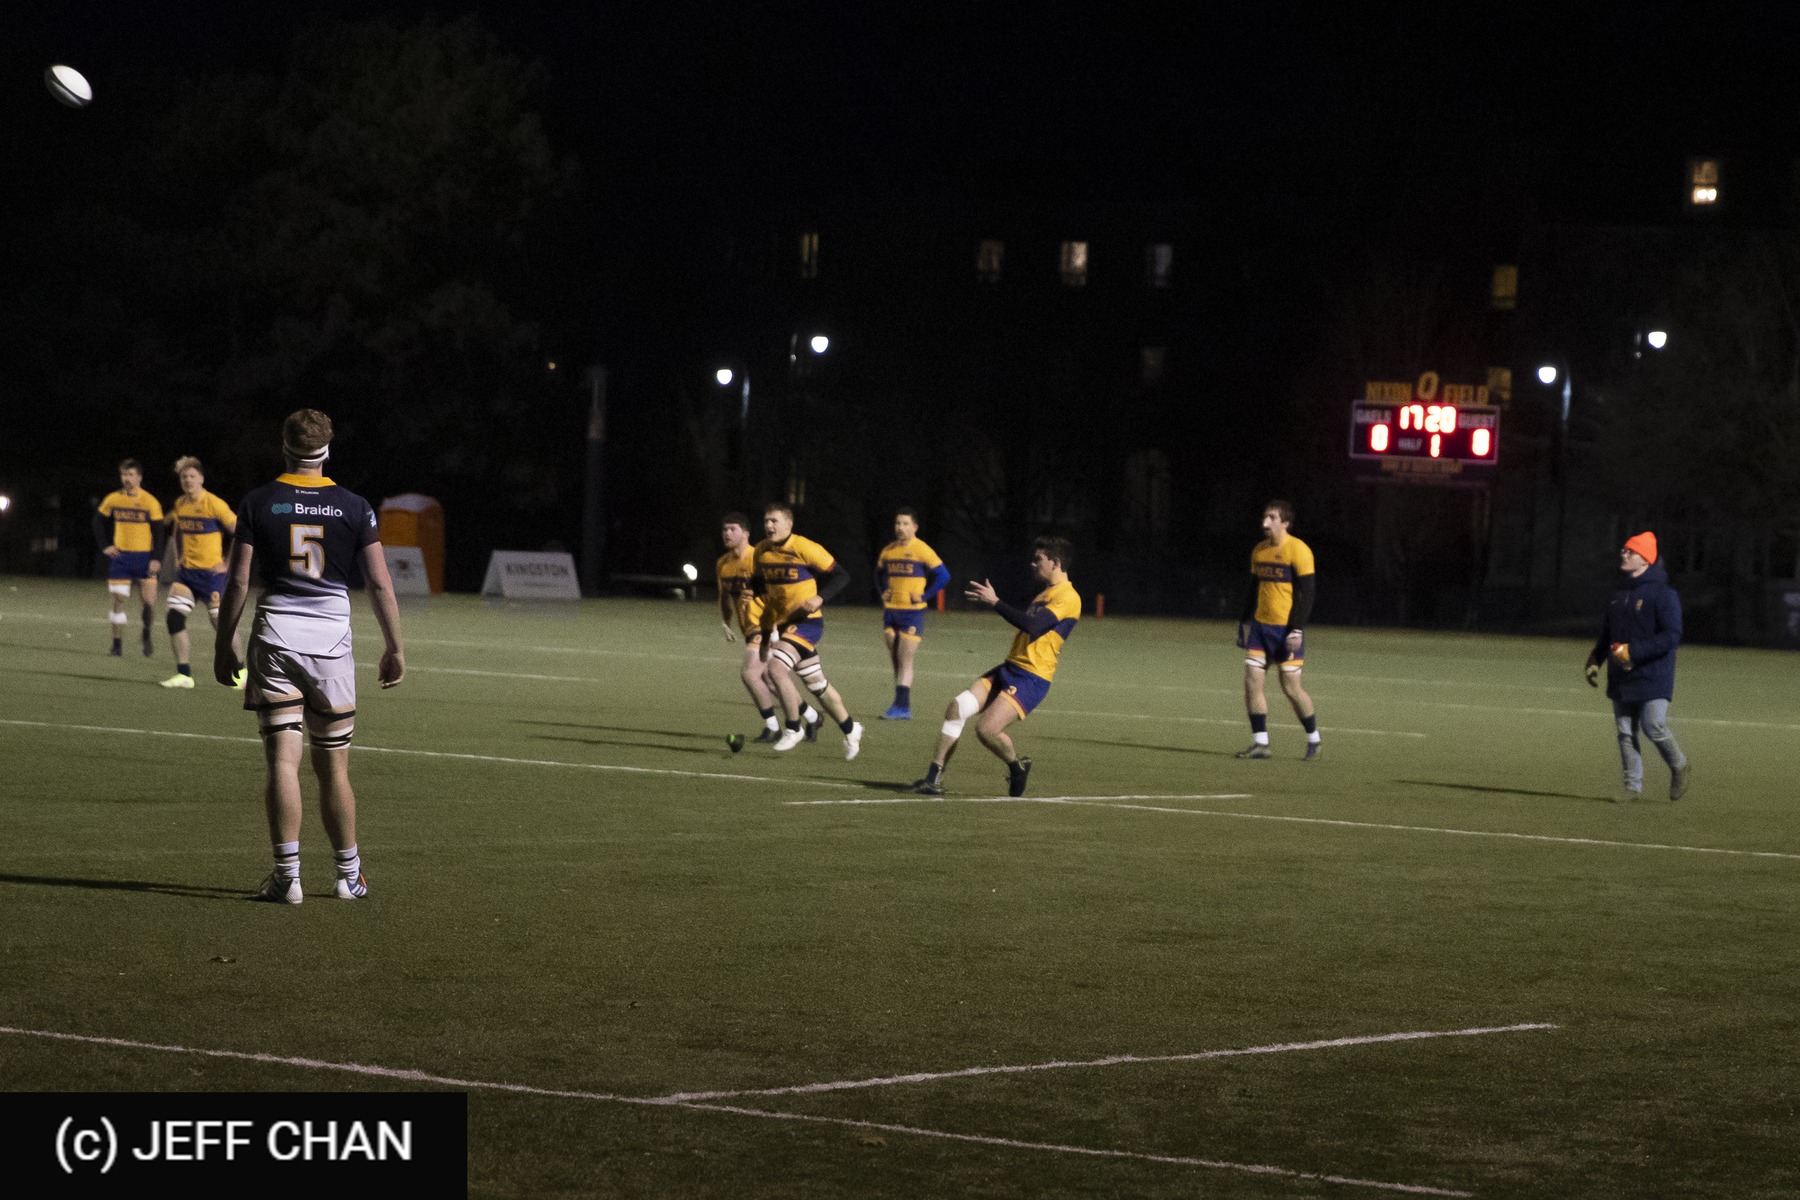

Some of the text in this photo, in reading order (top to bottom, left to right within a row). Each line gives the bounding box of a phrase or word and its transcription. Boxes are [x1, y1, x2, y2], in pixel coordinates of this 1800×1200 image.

[1430, 434, 1441, 458] 1
[295, 503, 343, 517] Braidio
[289, 524, 325, 579] 5
